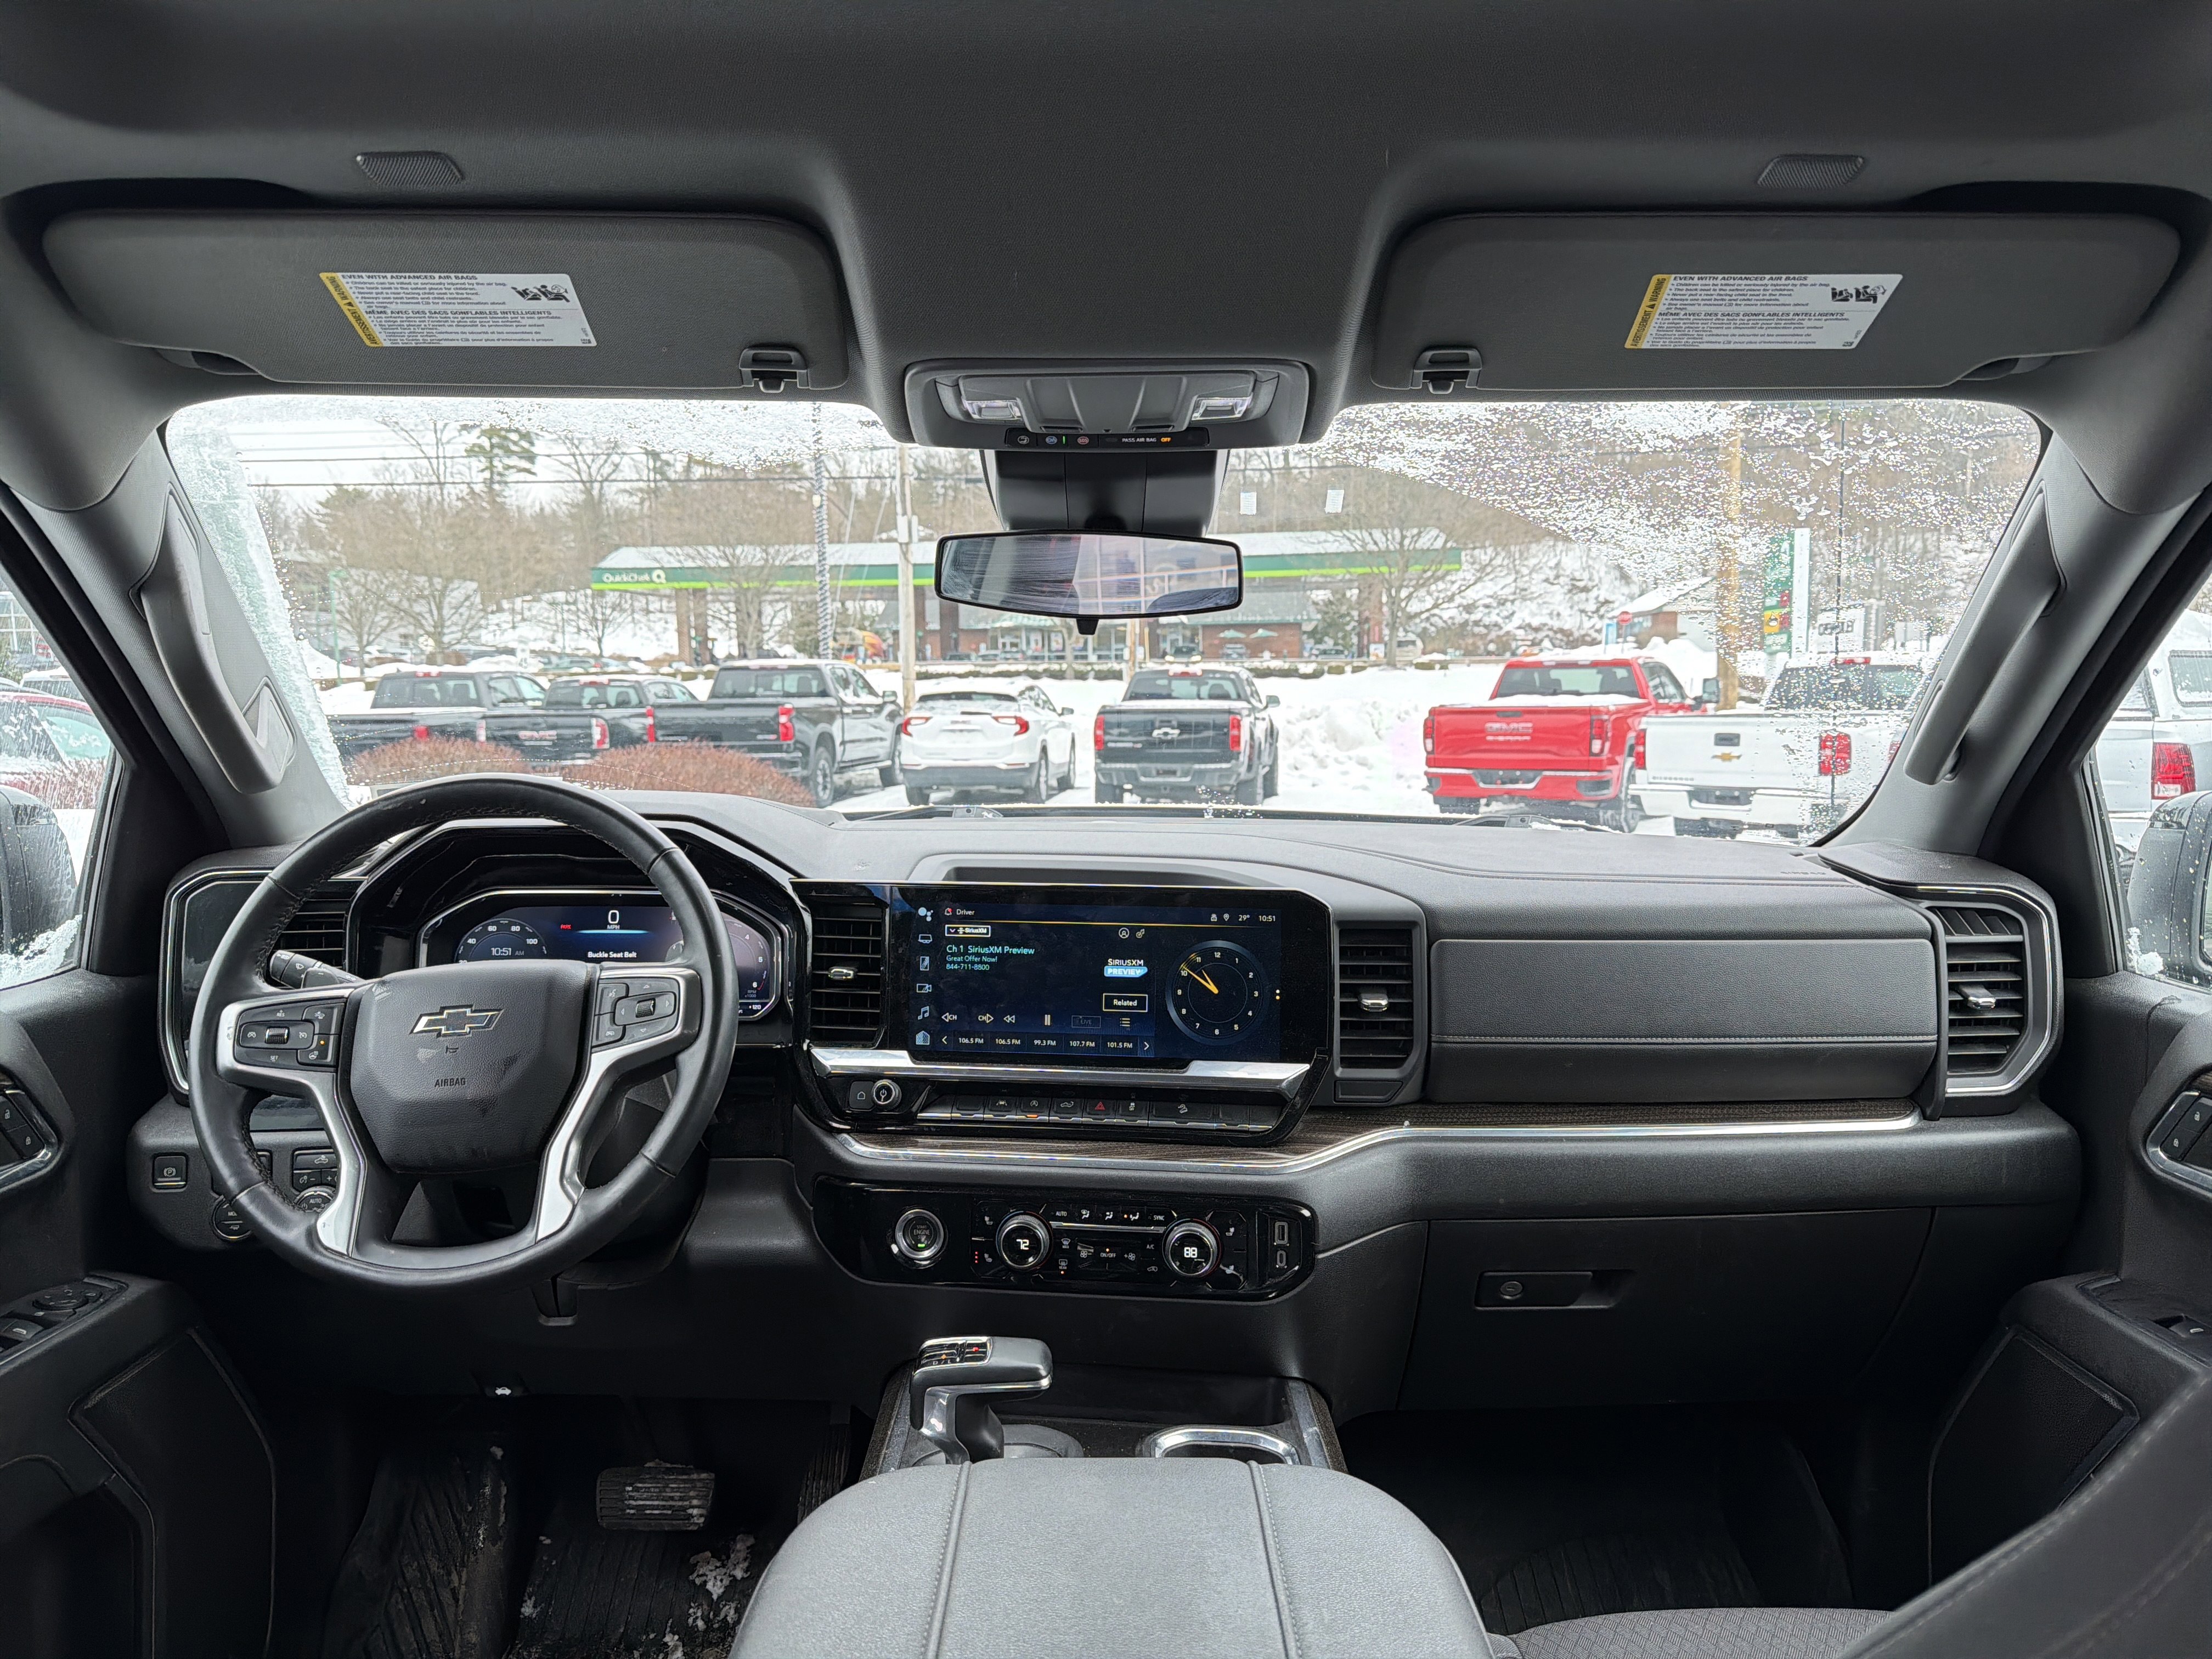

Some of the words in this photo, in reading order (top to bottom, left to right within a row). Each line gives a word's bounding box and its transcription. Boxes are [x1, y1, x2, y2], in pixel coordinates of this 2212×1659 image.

[1649, 278, 1666, 302] WARNING
[1485, 722, 1533, 733] GMC
[608, 910, 619, 923] 0
[491, 947, 511, 956] 10:51
[968, 945, 1002, 953] SiriusXM
[434, 1077, 466, 1087] AIRBAG
[1016, 1239, 1029, 1250] 72
